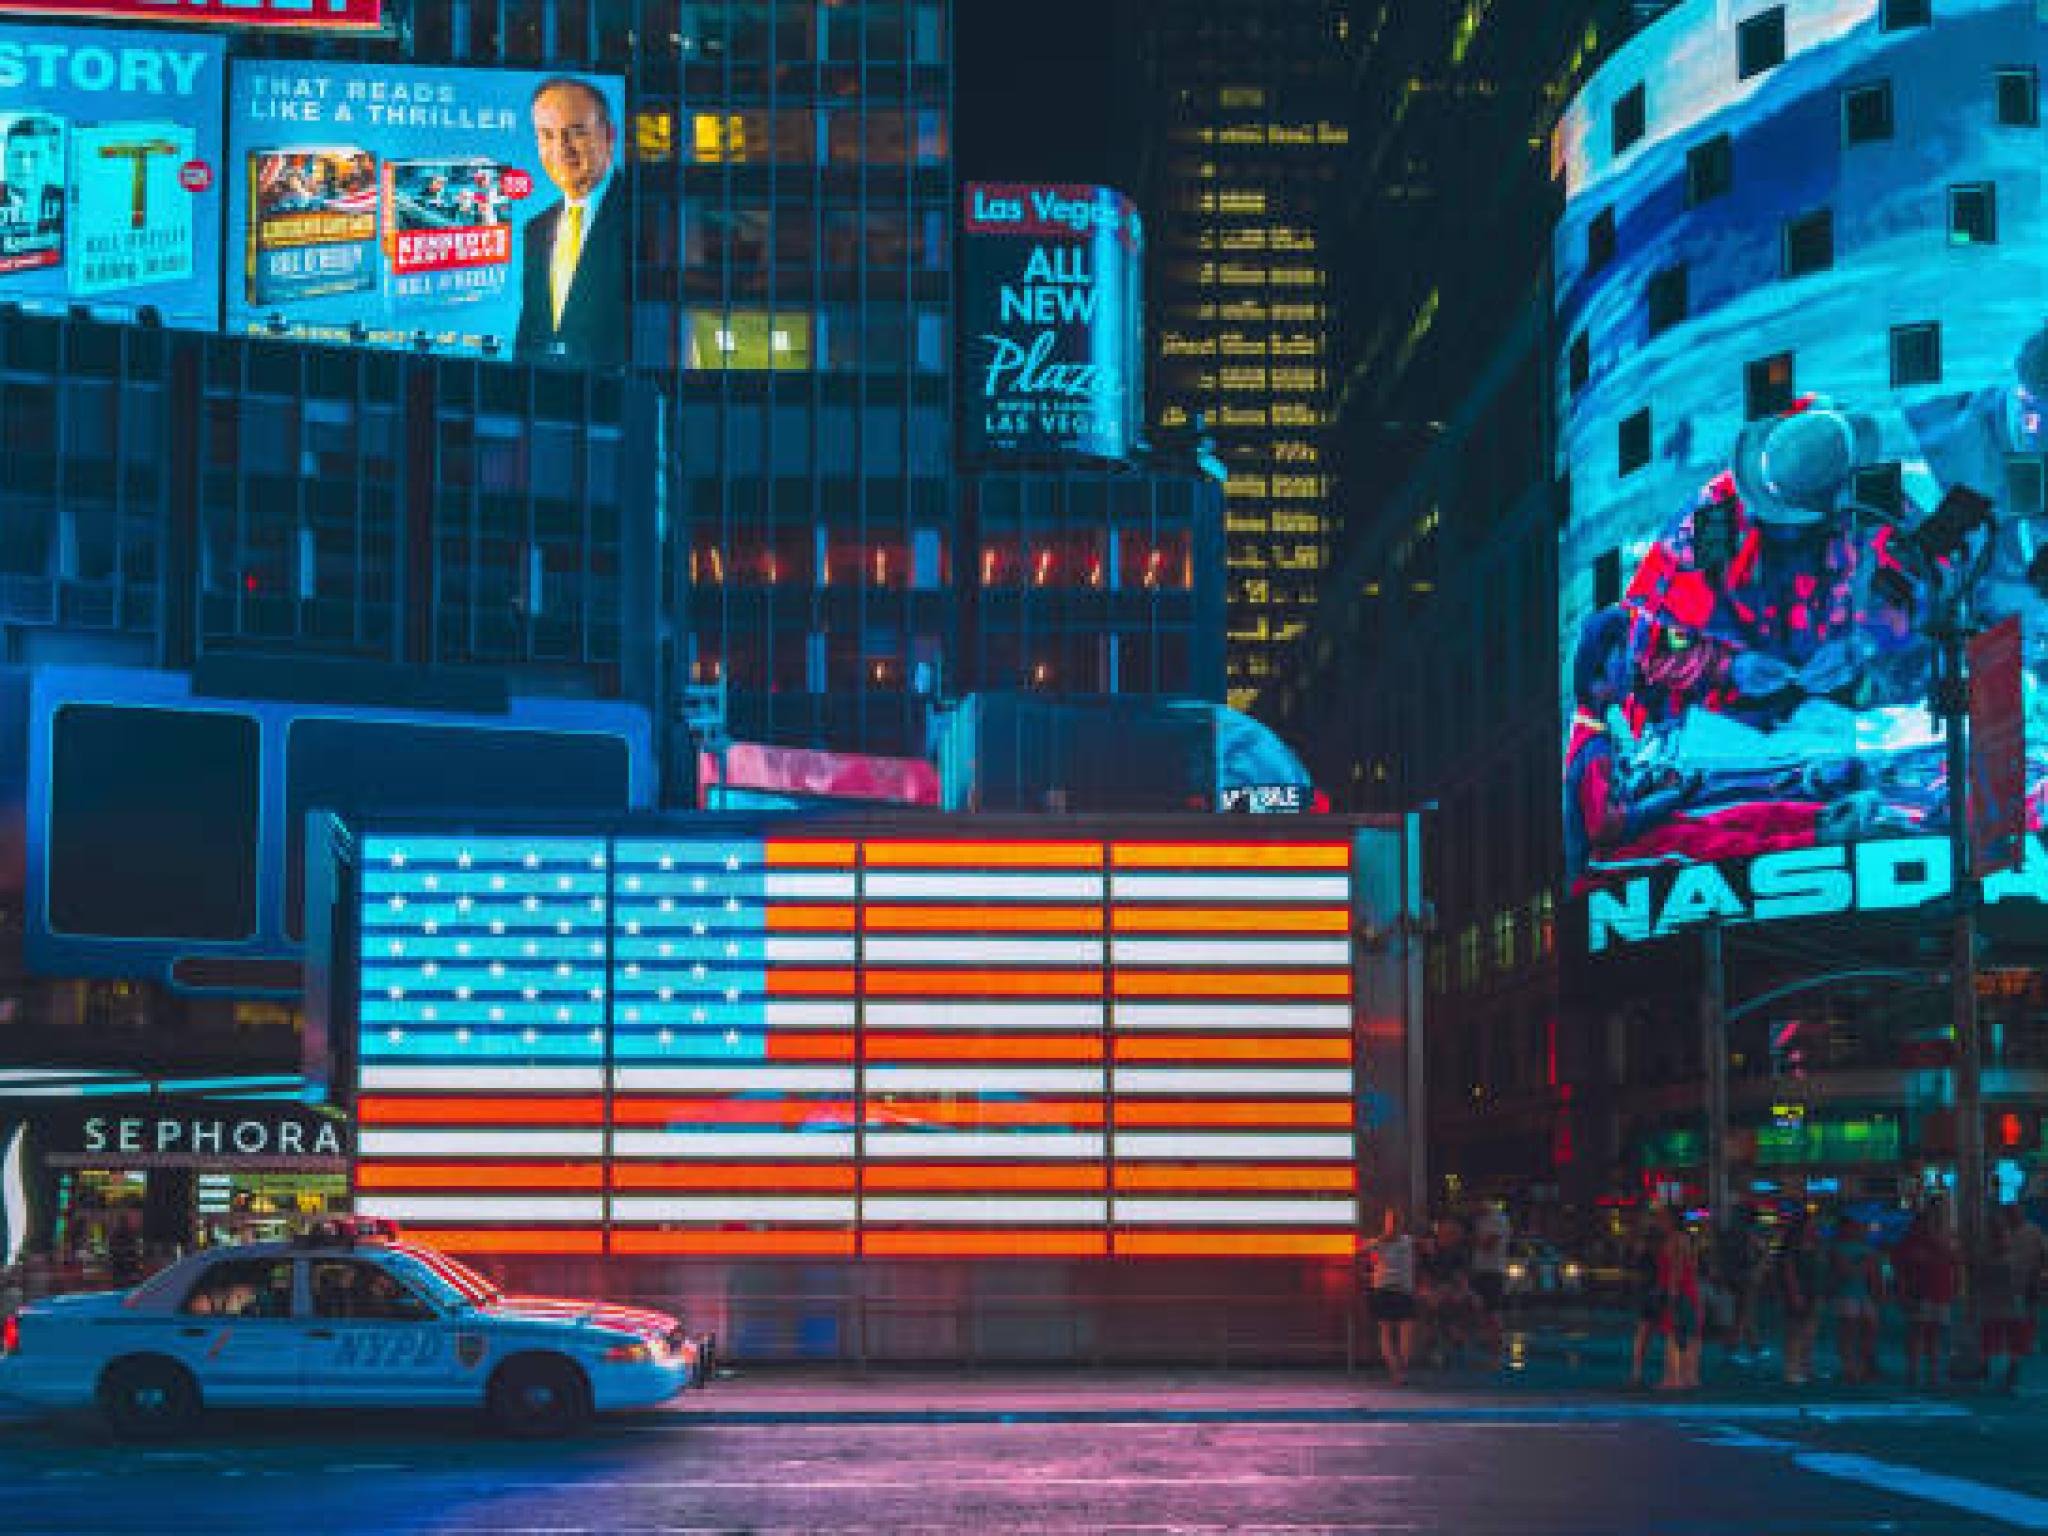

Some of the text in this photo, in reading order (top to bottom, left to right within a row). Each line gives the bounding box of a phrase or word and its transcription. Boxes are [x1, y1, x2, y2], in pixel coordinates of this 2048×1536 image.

[255, 77, 456, 103] THAT READS
[251, 99, 517, 129] LIKE A THRILLER
[974, 188, 1024, 222] Las
[1024, 245, 1092, 283] ALL
[1000, 285, 1097, 325] NEW
[985, 414, 1029, 433] LAS
[83, 1117, 340, 1153] SEPHORA
